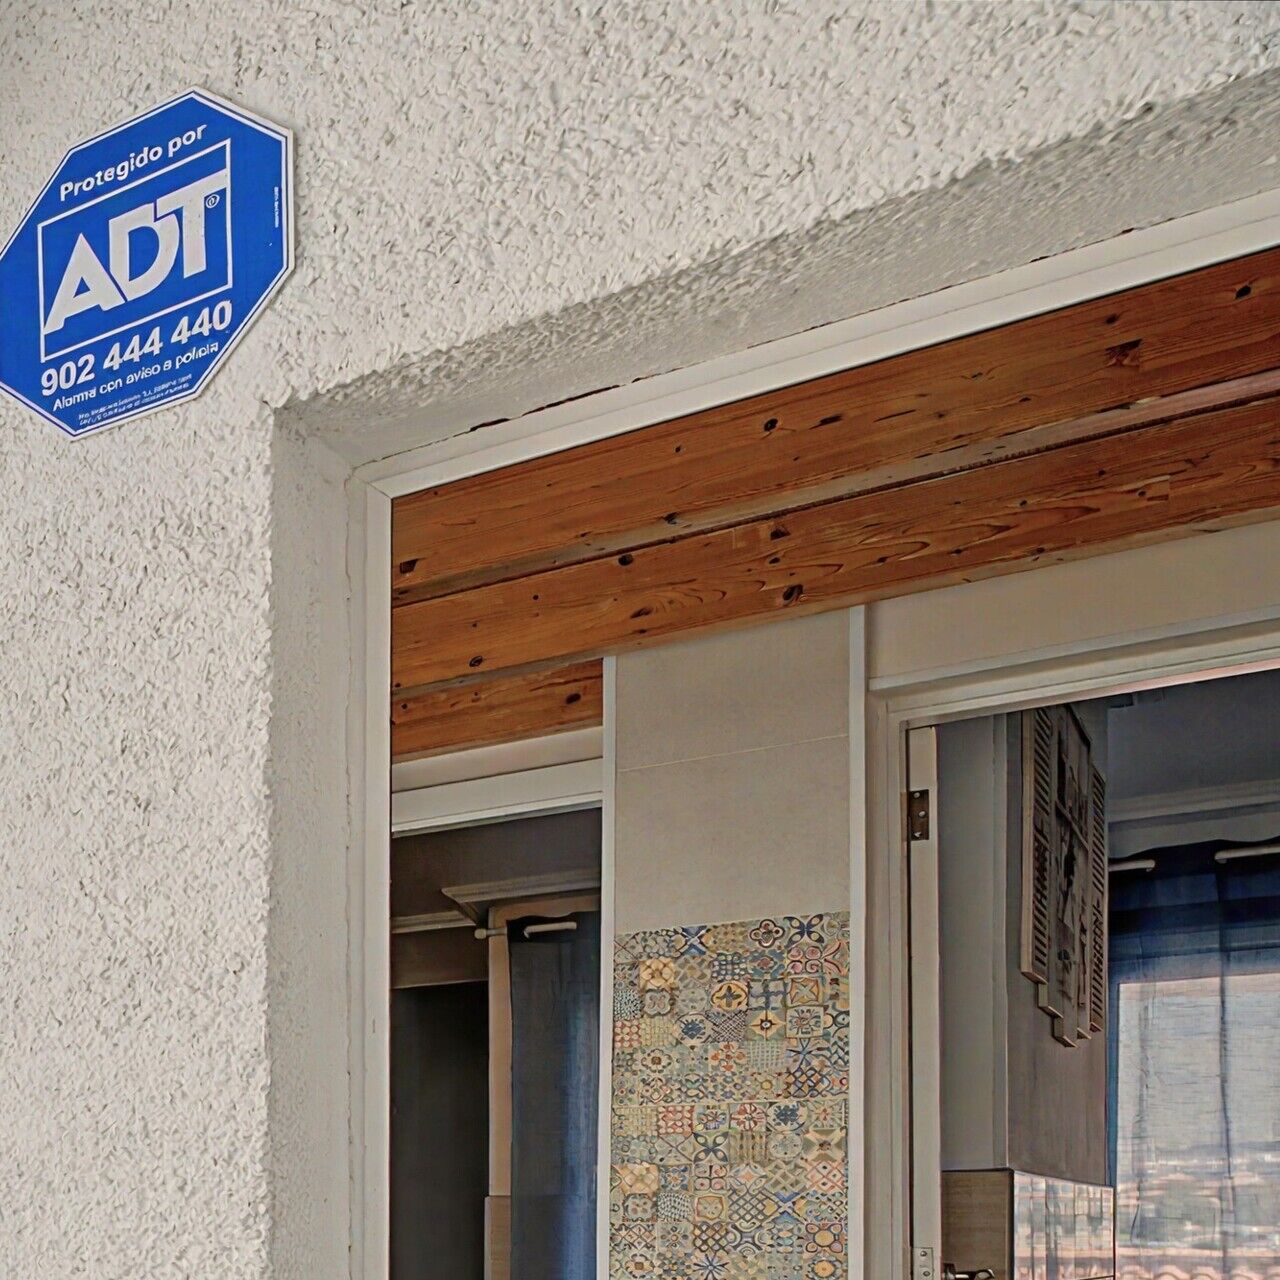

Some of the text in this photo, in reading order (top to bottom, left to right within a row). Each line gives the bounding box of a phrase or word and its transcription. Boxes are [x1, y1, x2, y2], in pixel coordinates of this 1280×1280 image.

[60, 124, 207, 202] Protegido por
[42, 168, 228, 335] ADT
[40, 300, 233, 396] 902 444 440
[126, 364, 161, 385] aviso
